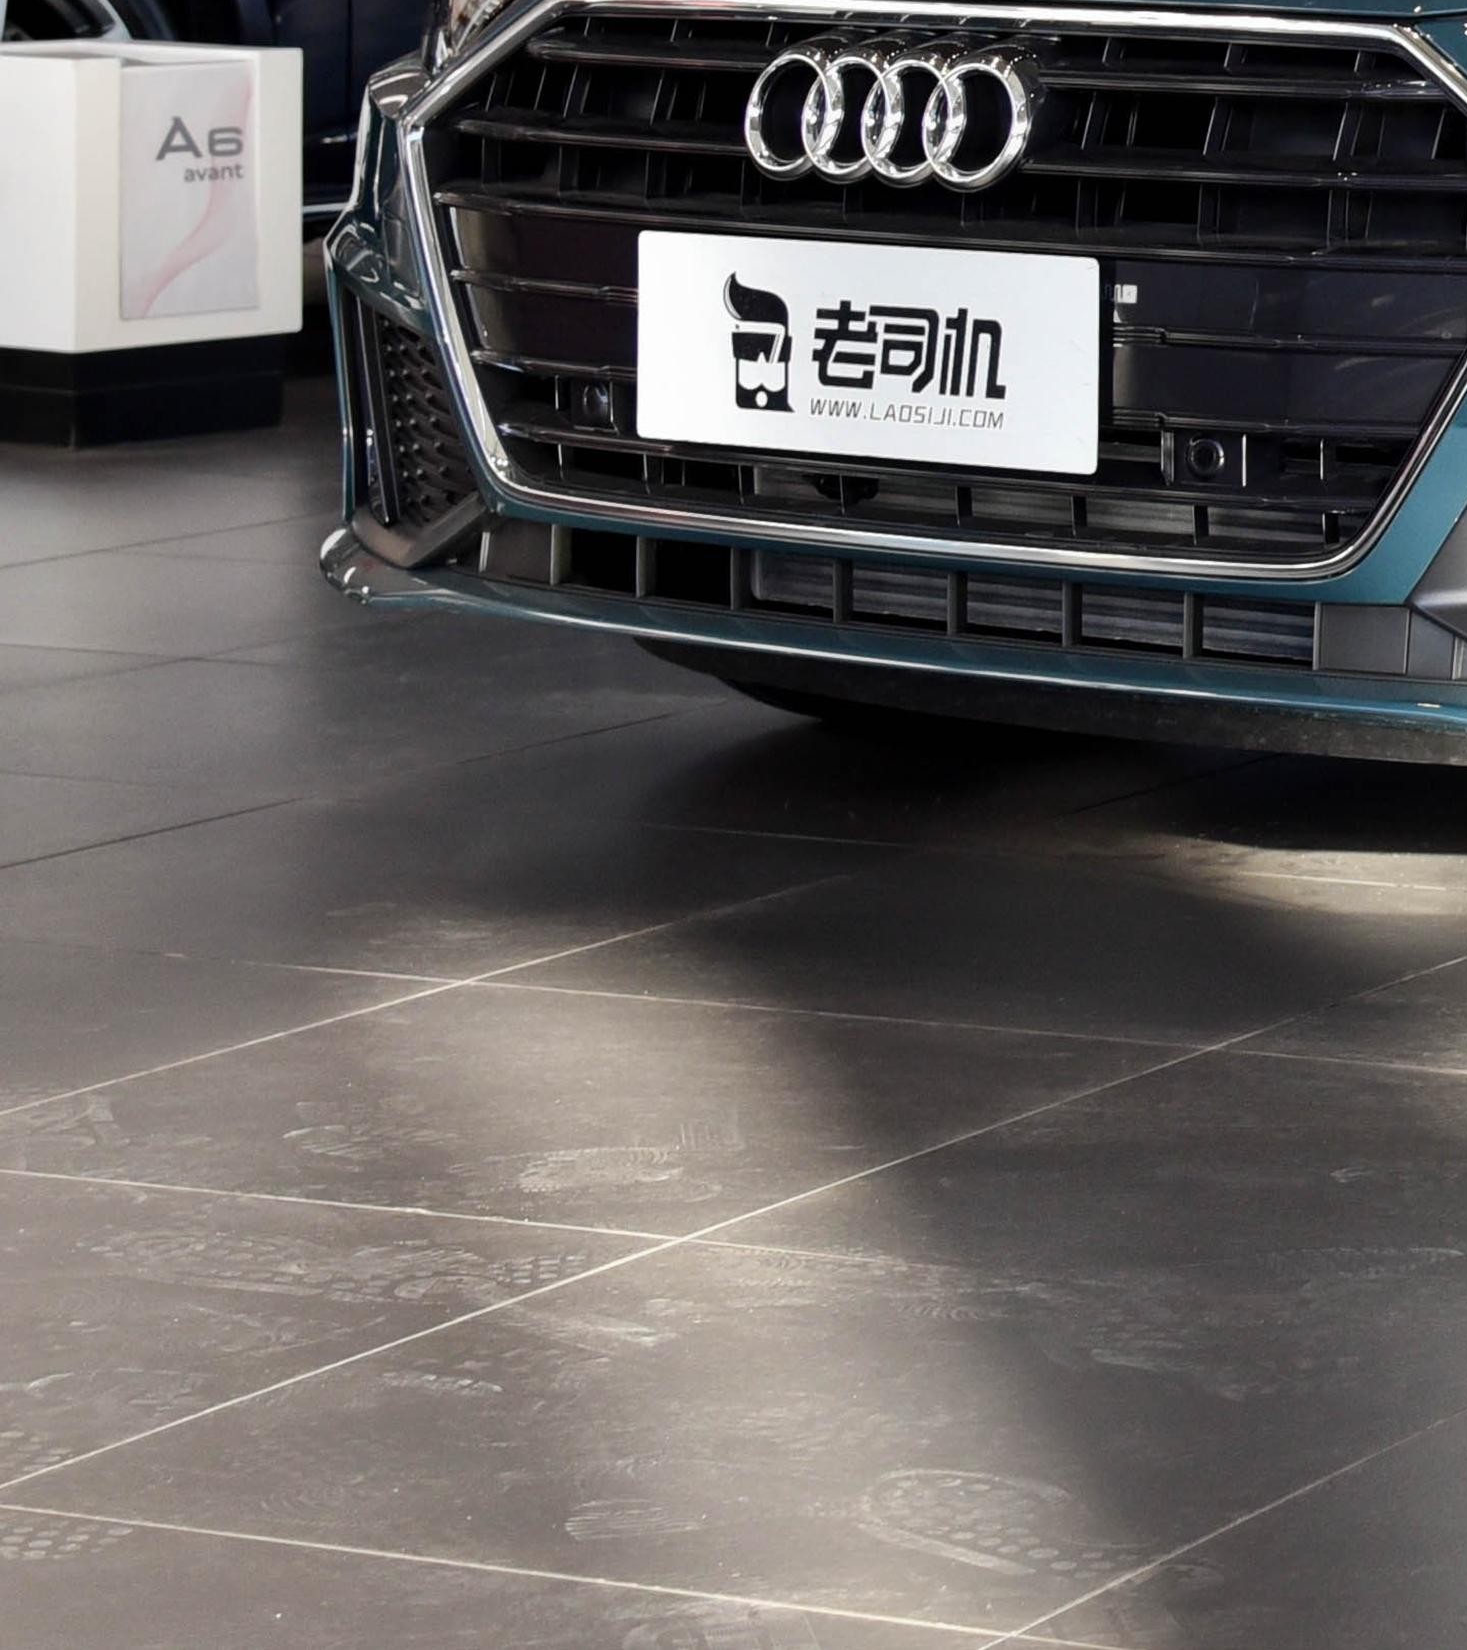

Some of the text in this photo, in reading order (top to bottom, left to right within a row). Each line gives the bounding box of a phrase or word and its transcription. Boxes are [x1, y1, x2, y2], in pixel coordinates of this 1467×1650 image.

[155, 116, 244, 160] A6
[183, 164, 244, 183] avant
[812, 300, 1007, 400] 老司机
[809, 398, 1005, 430] WWW.LAOSIJI.COM
